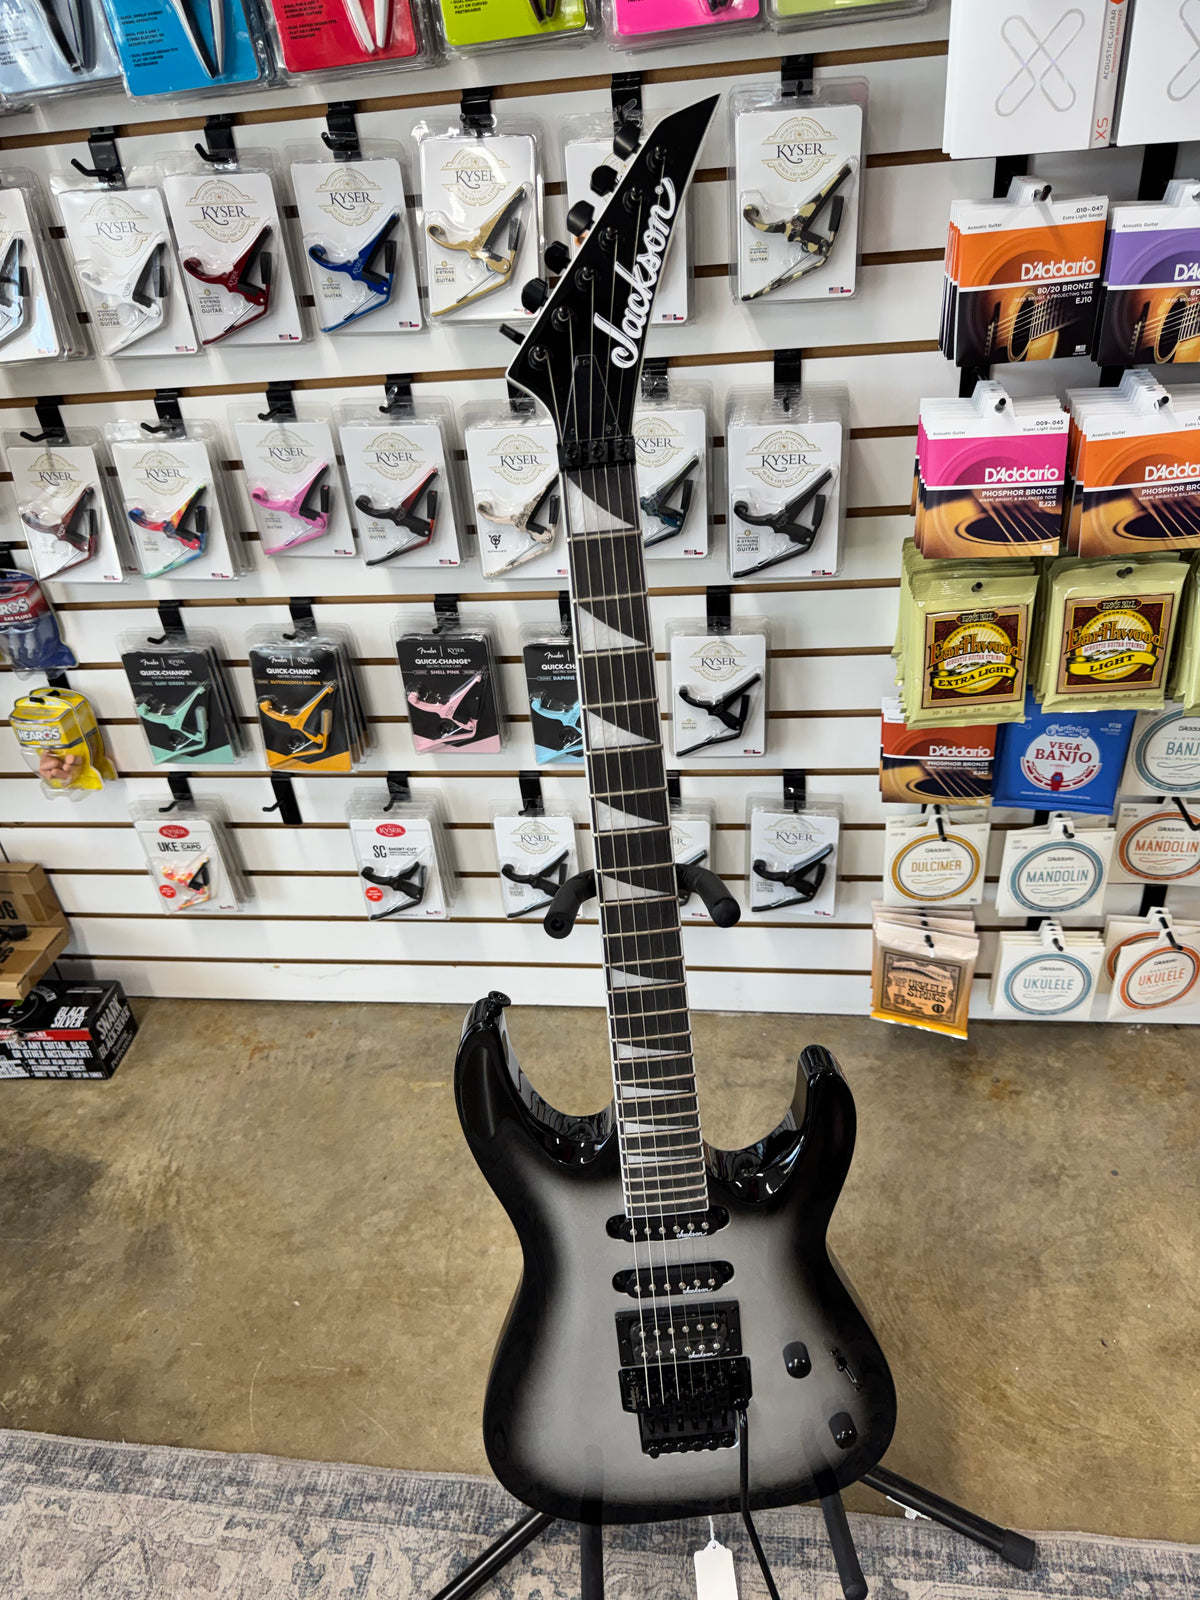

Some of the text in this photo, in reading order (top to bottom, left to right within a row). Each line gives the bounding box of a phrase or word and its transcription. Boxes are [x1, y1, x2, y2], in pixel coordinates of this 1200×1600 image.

[1103, 10, 1117, 79] ACOUSTIC GUITAR
[1095, 117, 1109, 141] XS
[777, 142, 824, 164] KYSER
[329, 191, 372, 211] KYSER
[201, 205, 247, 225] KYSER
[96, 221, 140, 240] KYSER
[593, 177, 676, 369] Jackson
[1021, 256, 1096, 280] D'Addario
[1038, 282, 1094, 294] 80/20 BRONZE
[1075, 296, 1092, 304] EJ10
[268, 447, 304, 462] KYSER
[375, 452, 413, 467] KYSER
[500, 455, 540, 471] KYSER
[761, 454, 809, 472] KYSER
[145, 468, 181, 483] KYSER
[984, 465, 1059, 482] D'Addario
[1145, 462, 1200, 480] D'Adda
[39, 471, 73, 486] KYSER
[982, 489, 1024, 497] PHOSPHOR
[1141, 486, 1184, 495] PHOSPHOR
[15, 613, 32, 621] PLUGS
[1132, 614, 1147, 626] ALLOY
[990, 626, 1005, 639] ALLOY
[1065, 621, 1166, 655] Earthwood
[417, 647, 437, 655] Fender
[928, 634, 1023, 667] Earthwood
[1084, 643, 1106, 653] ACOUSTIC
[1125, 642, 1146, 650] STRINGS
[544, 651, 564, 660] Fender
[946, 655, 967, 666] ACOUSTIC
[986, 654, 1005, 662] STRINGS
[701, 658, 737, 670] KYSER
[1089, 654, 1135, 672] LIGHT
[938, 666, 1012, 687] EXTRA LIGHT
[16, 727, 61, 742] HEAROS
[929, 745, 990, 756] D'Addario
[1049, 742, 1081, 751] VEGA
[1166, 742, 1200, 755] BANJ
[1035, 749, 1092, 764] BANJO
[379, 828, 402, 836] KYSER
[777, 832, 815, 844] KYSER
[521, 835, 551, 845] KYSER
[1135, 839, 1199, 853] MANDOLIN
[158, 842, 179, 852] UKE
[373, 845, 387, 858] SC
[911, 860, 962, 872] DULCIMER
[1026, 869, 1089, 883] MANDOLIN
[1138, 968, 1185, 986] UKULELE
[908, 979, 947, 995] UKULELE
[1023, 978, 1074, 990] UKULELE
[907, 989, 946, 1003] STRINGS
[56, 1006, 90, 1018] BLACK
[96, 992, 122, 1040] SNARK
[50, 1017, 85, 1028] SILVER
[71, 1041, 90, 1049] BASS
[45, 1050, 94, 1058] INSTRUMENT!
[676, 1229, 707, 1238] Jackson
[683, 1286, 713, 1294] Jackson
[688, 1350, 718, 1359] Jackson
